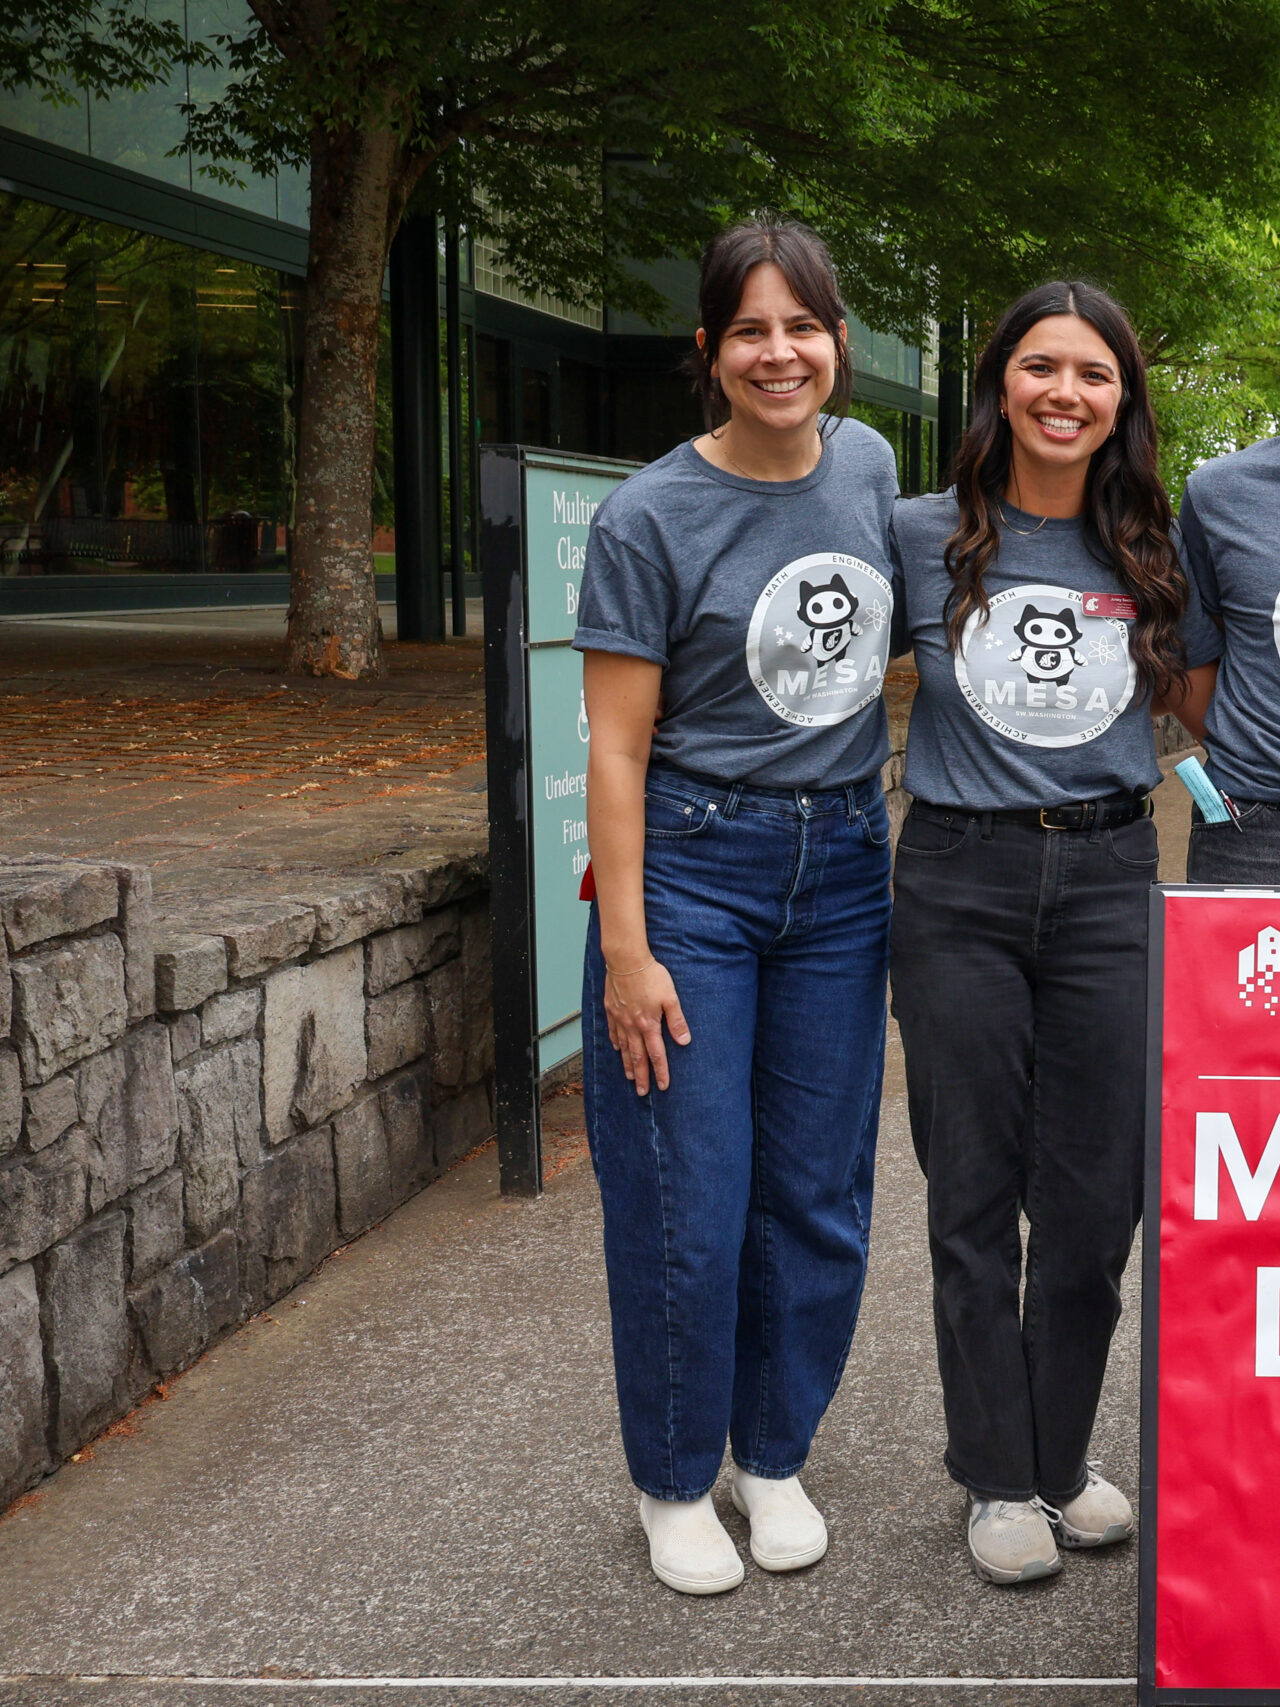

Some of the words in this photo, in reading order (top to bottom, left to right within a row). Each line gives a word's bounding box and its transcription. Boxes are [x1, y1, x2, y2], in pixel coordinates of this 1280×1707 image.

[765, 572, 789, 598] MATH
[832, 555, 892, 596] ENGINEERING
[988, 591, 1017, 609] MATH
[776, 655, 882, 696] MESA
[961, 684, 1028, 741] ACHIEVEMENT
[984, 679, 1110, 713] MESA
[1028, 711, 1077, 721] WASHINGTON
[1081, 708, 1120, 741] SCIENCE
[563, 819, 588, 845] Fitn
